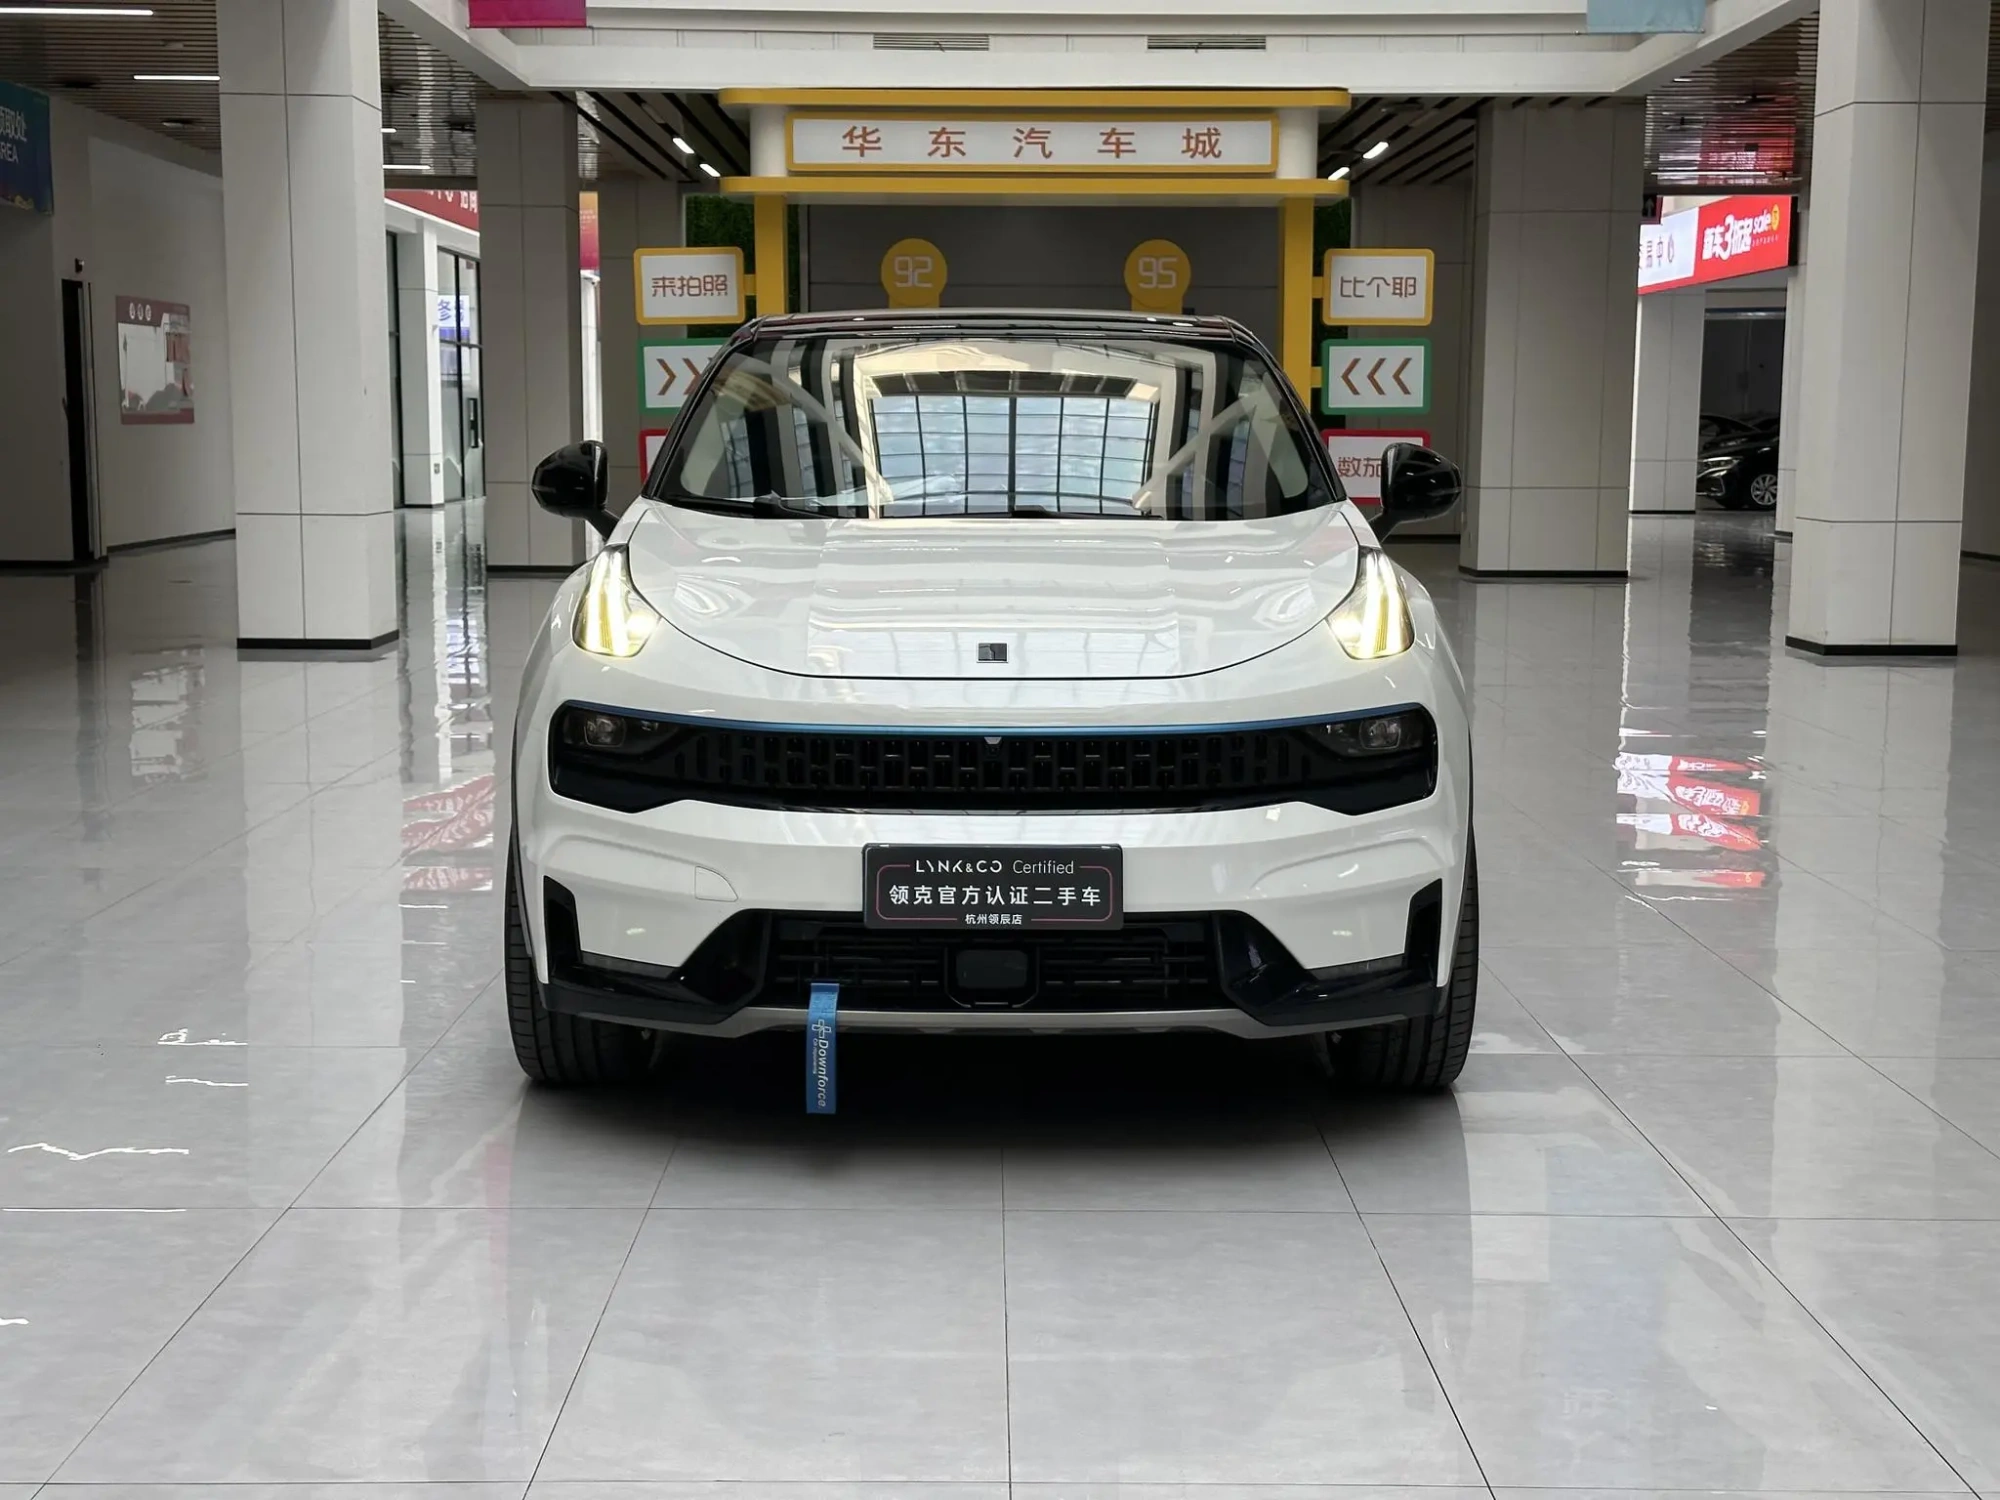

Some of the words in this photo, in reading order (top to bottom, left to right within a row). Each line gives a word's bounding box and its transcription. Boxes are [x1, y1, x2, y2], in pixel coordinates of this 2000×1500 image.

[842, 125, 1222, 159] 华东汽车城
[894, 256, 933, 287] 92
[1138, 256, 1178, 288] 95
[651, 274, 728, 298] 来拍照
[1340, 276, 1417, 298] 比个耶
[1012, 859, 1075, 875] Certified
[888, 884, 1101, 907] 领克官方认证二手车
[964, 913, 1023, 925] 杭州领辰店
[816, 1039, 829, 1107] Downforce
